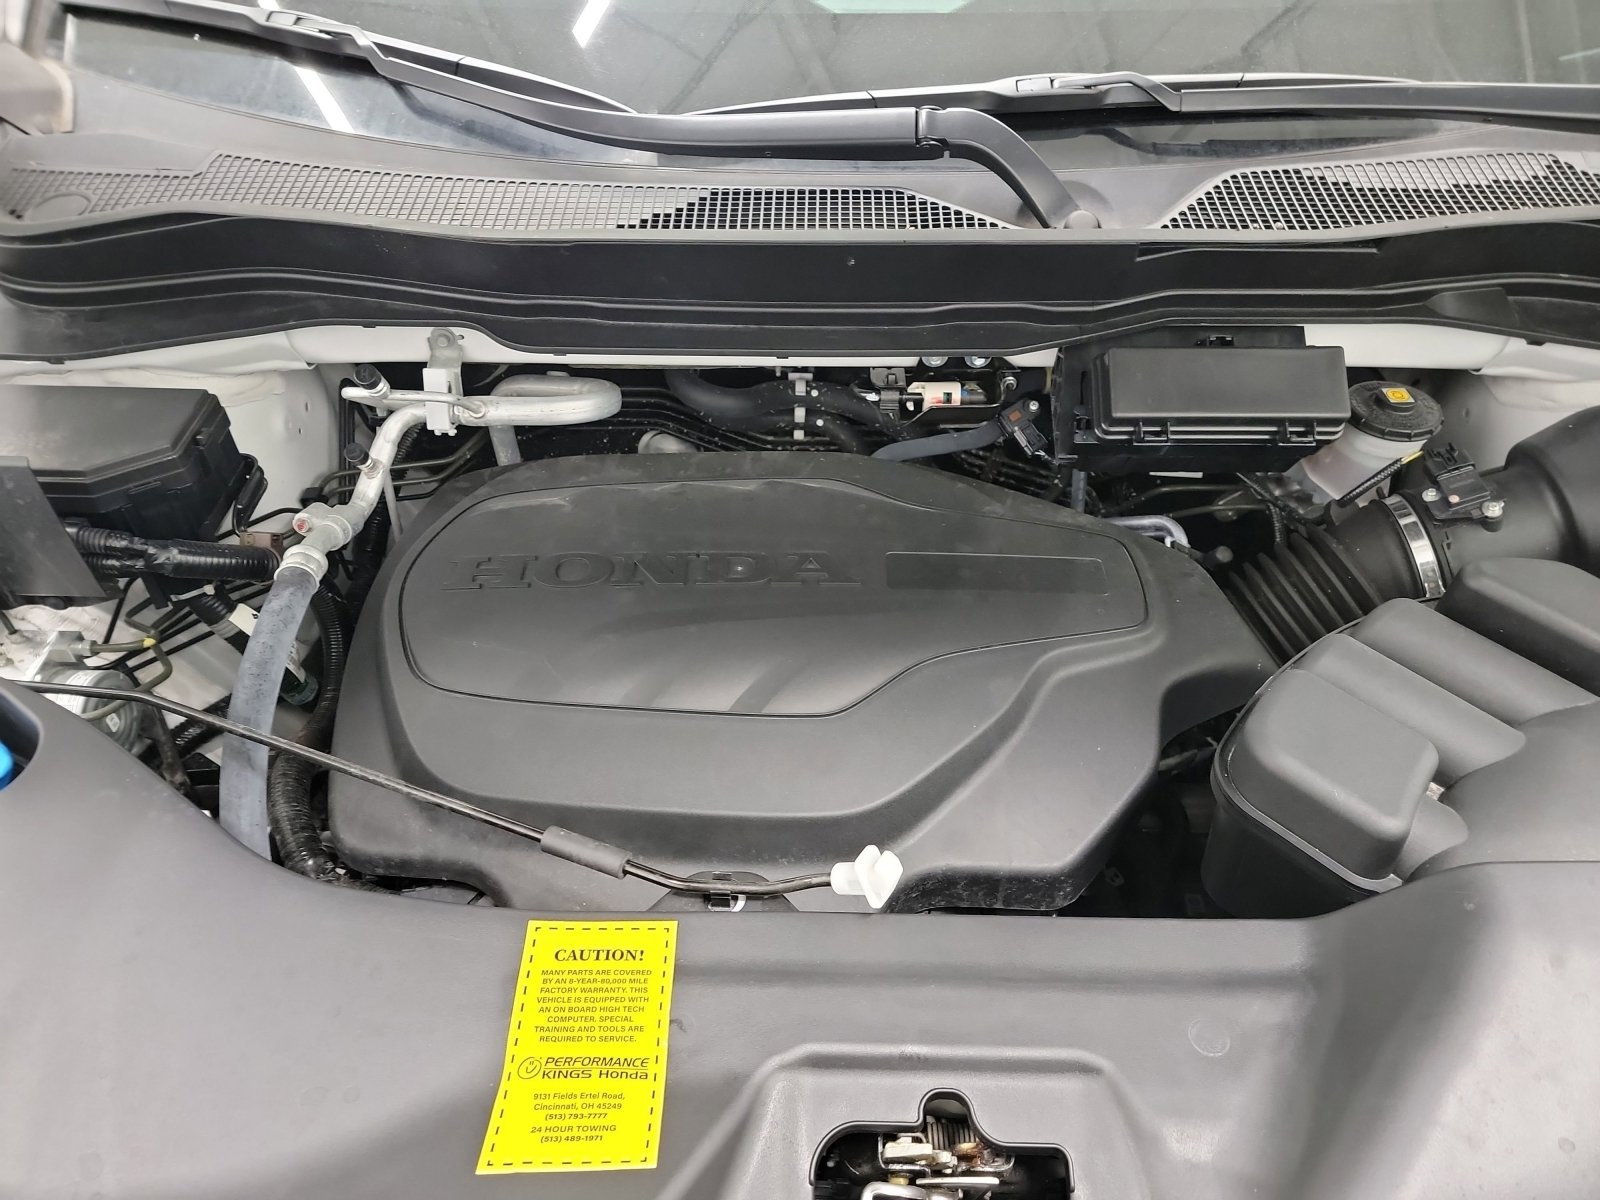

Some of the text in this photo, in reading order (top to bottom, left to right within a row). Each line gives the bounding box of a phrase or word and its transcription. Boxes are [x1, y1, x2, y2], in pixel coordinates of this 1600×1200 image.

[440, 551, 862, 590] HONDA
[554, 949, 644, 961] CAUTION!
[544, 1057, 650, 1068] PERFORMANCE
[542, 1070, 648, 1079] KINGS Honda
[534, 1103, 578, 1111] Cincinnati,
